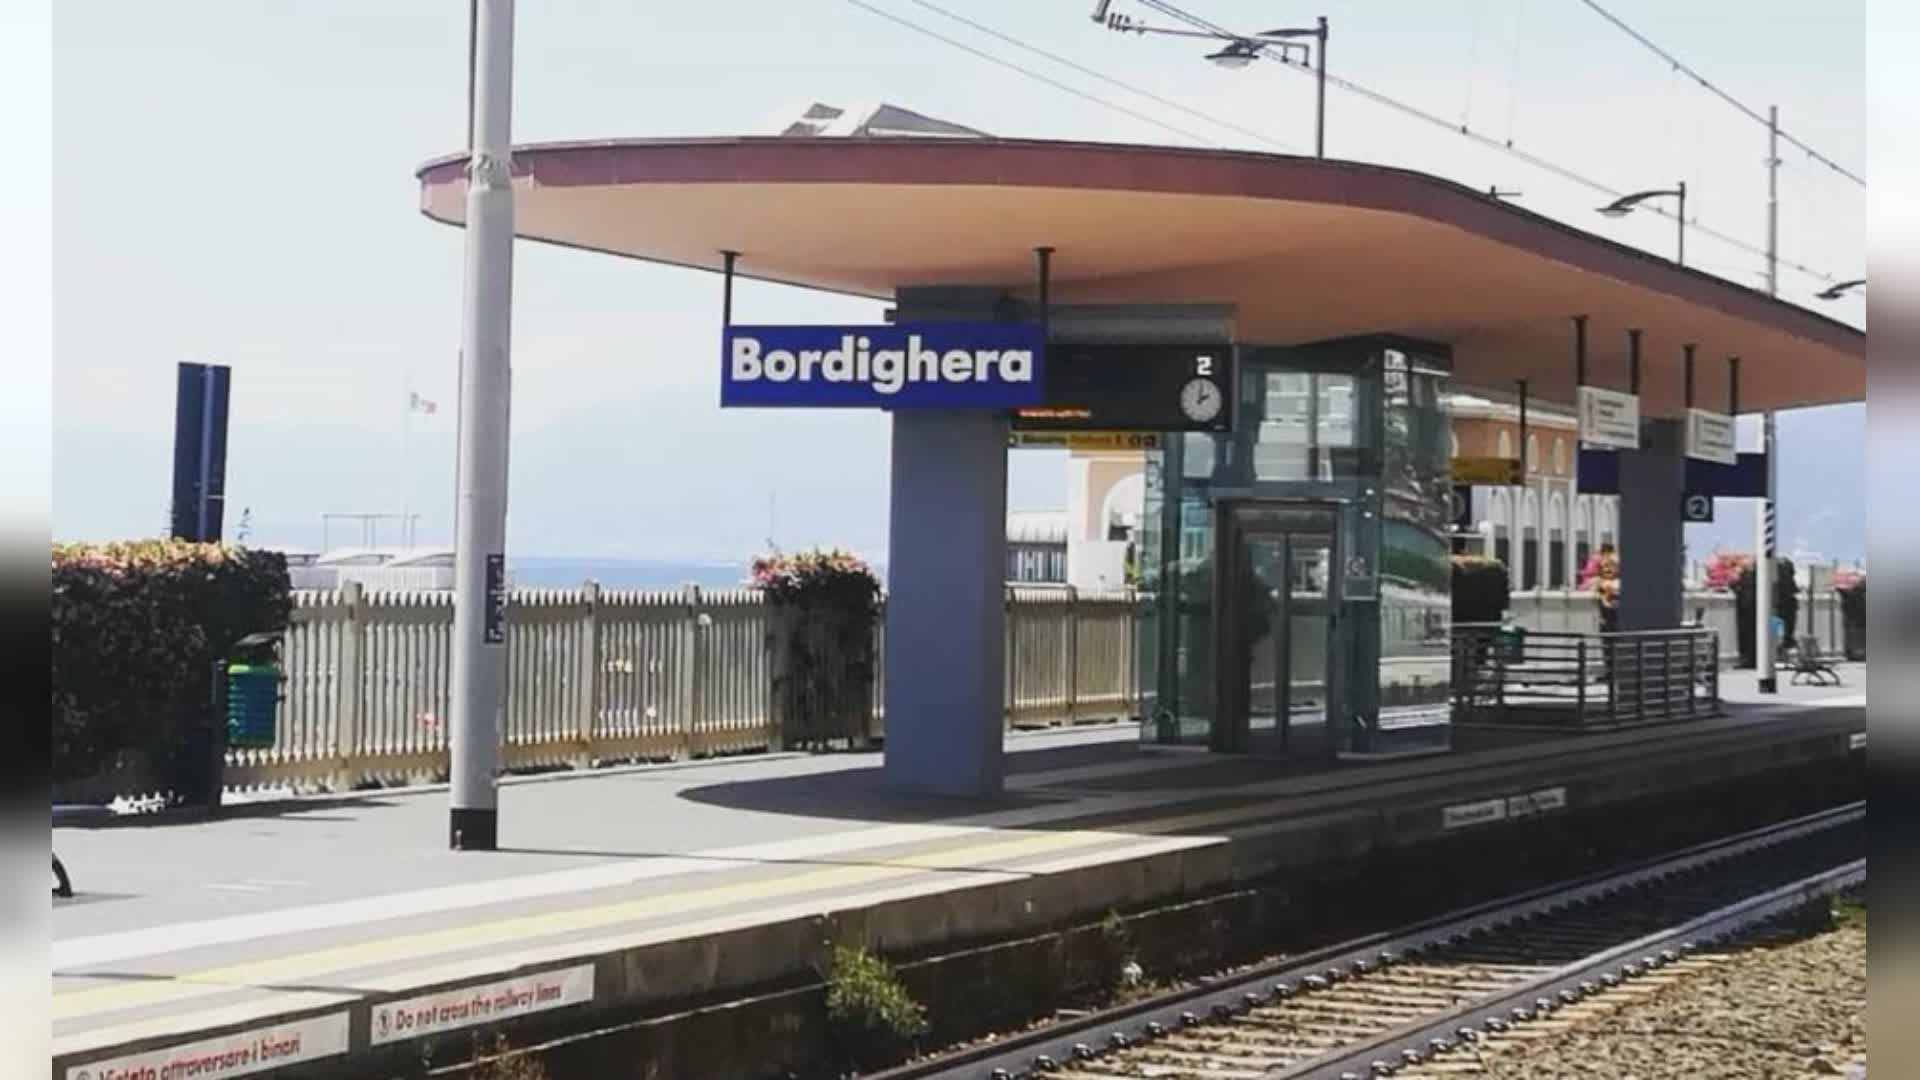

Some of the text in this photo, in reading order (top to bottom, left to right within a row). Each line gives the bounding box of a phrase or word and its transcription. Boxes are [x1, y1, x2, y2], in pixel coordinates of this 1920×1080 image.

[731, 335, 1033, 394] Bordighera
[1196, 356, 1213, 375] 2
[396, 982, 561, 1031] Do not cross the railway lines
[159, 1046, 249, 1080] attraversare
[260, 1036, 301, 1061] binari
